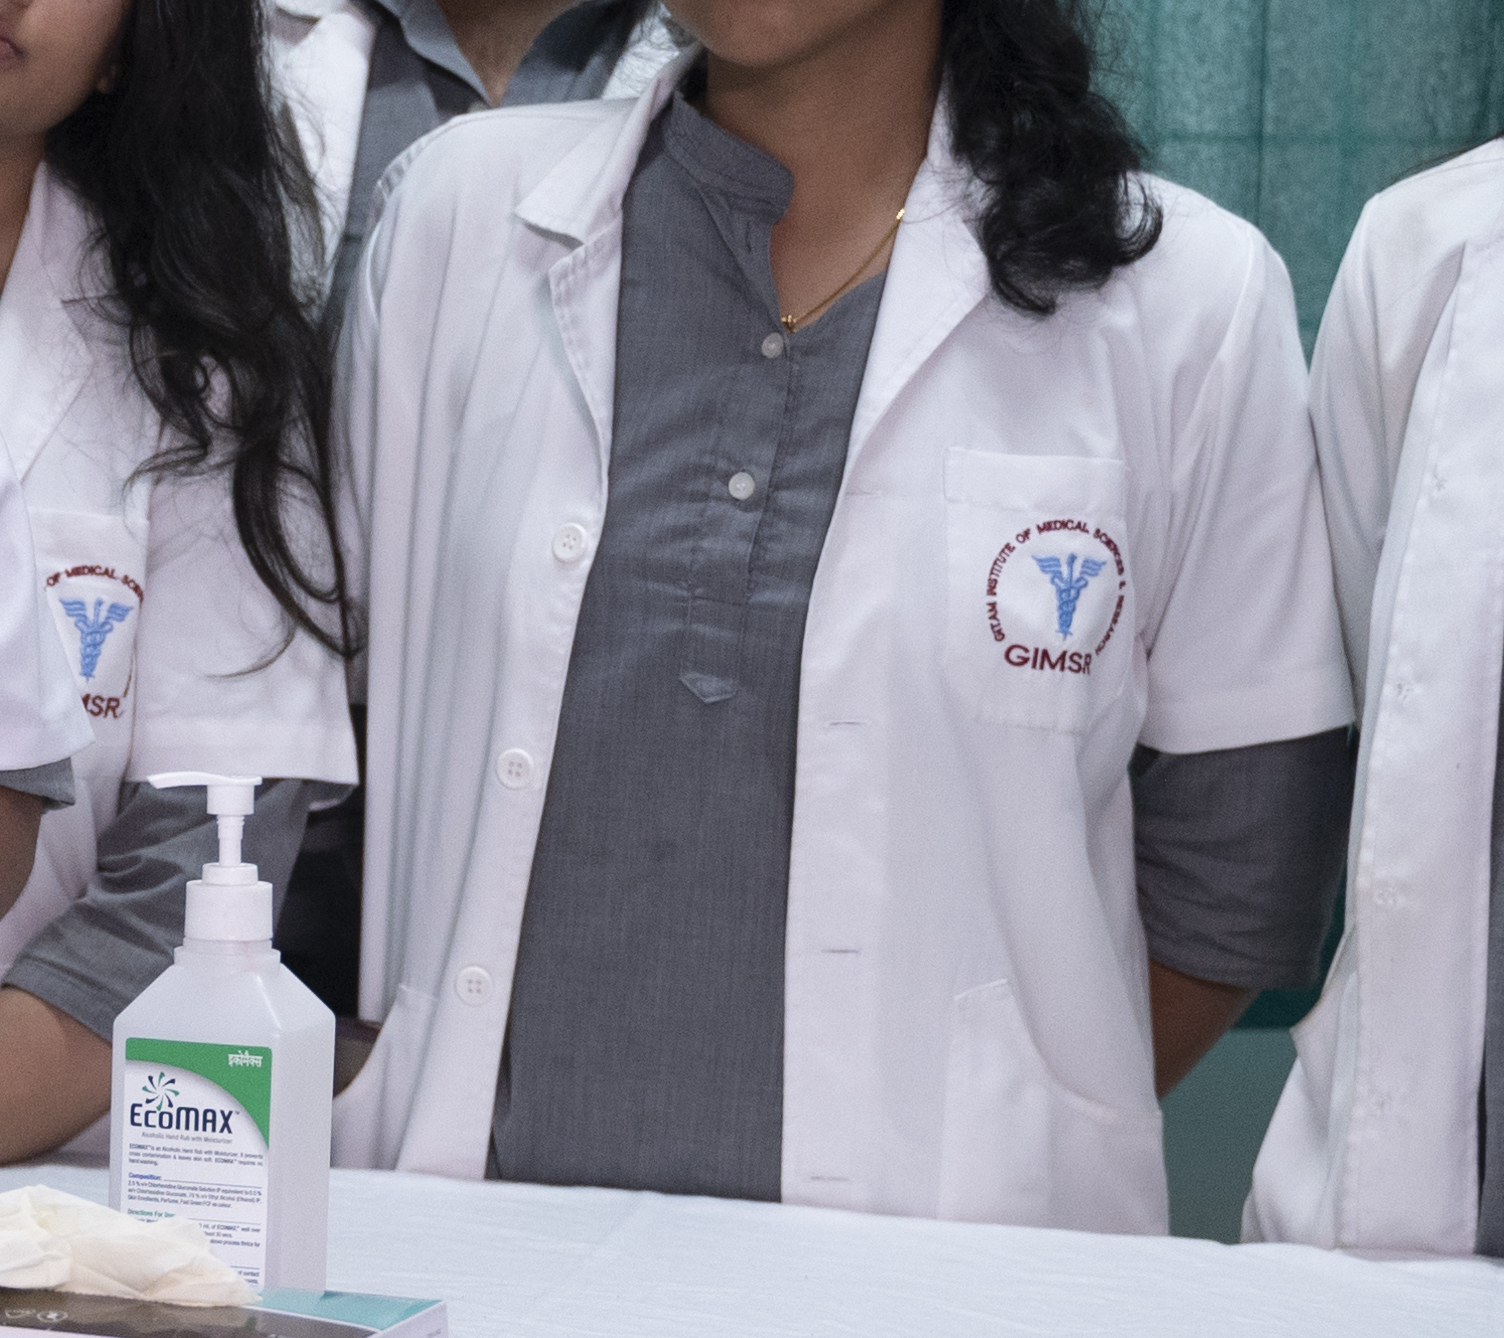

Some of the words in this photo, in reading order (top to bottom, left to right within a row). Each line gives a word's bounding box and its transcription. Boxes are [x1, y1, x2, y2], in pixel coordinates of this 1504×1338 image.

[1016, 528, 1031, 544] OF
[1036, 519, 1090, 535] MEDICAL
[986, 542, 1016, 596] INSTITUTE
[986, 601, 1005, 642] GITAM
[1004, 643, 1092, 675] GIMSR
